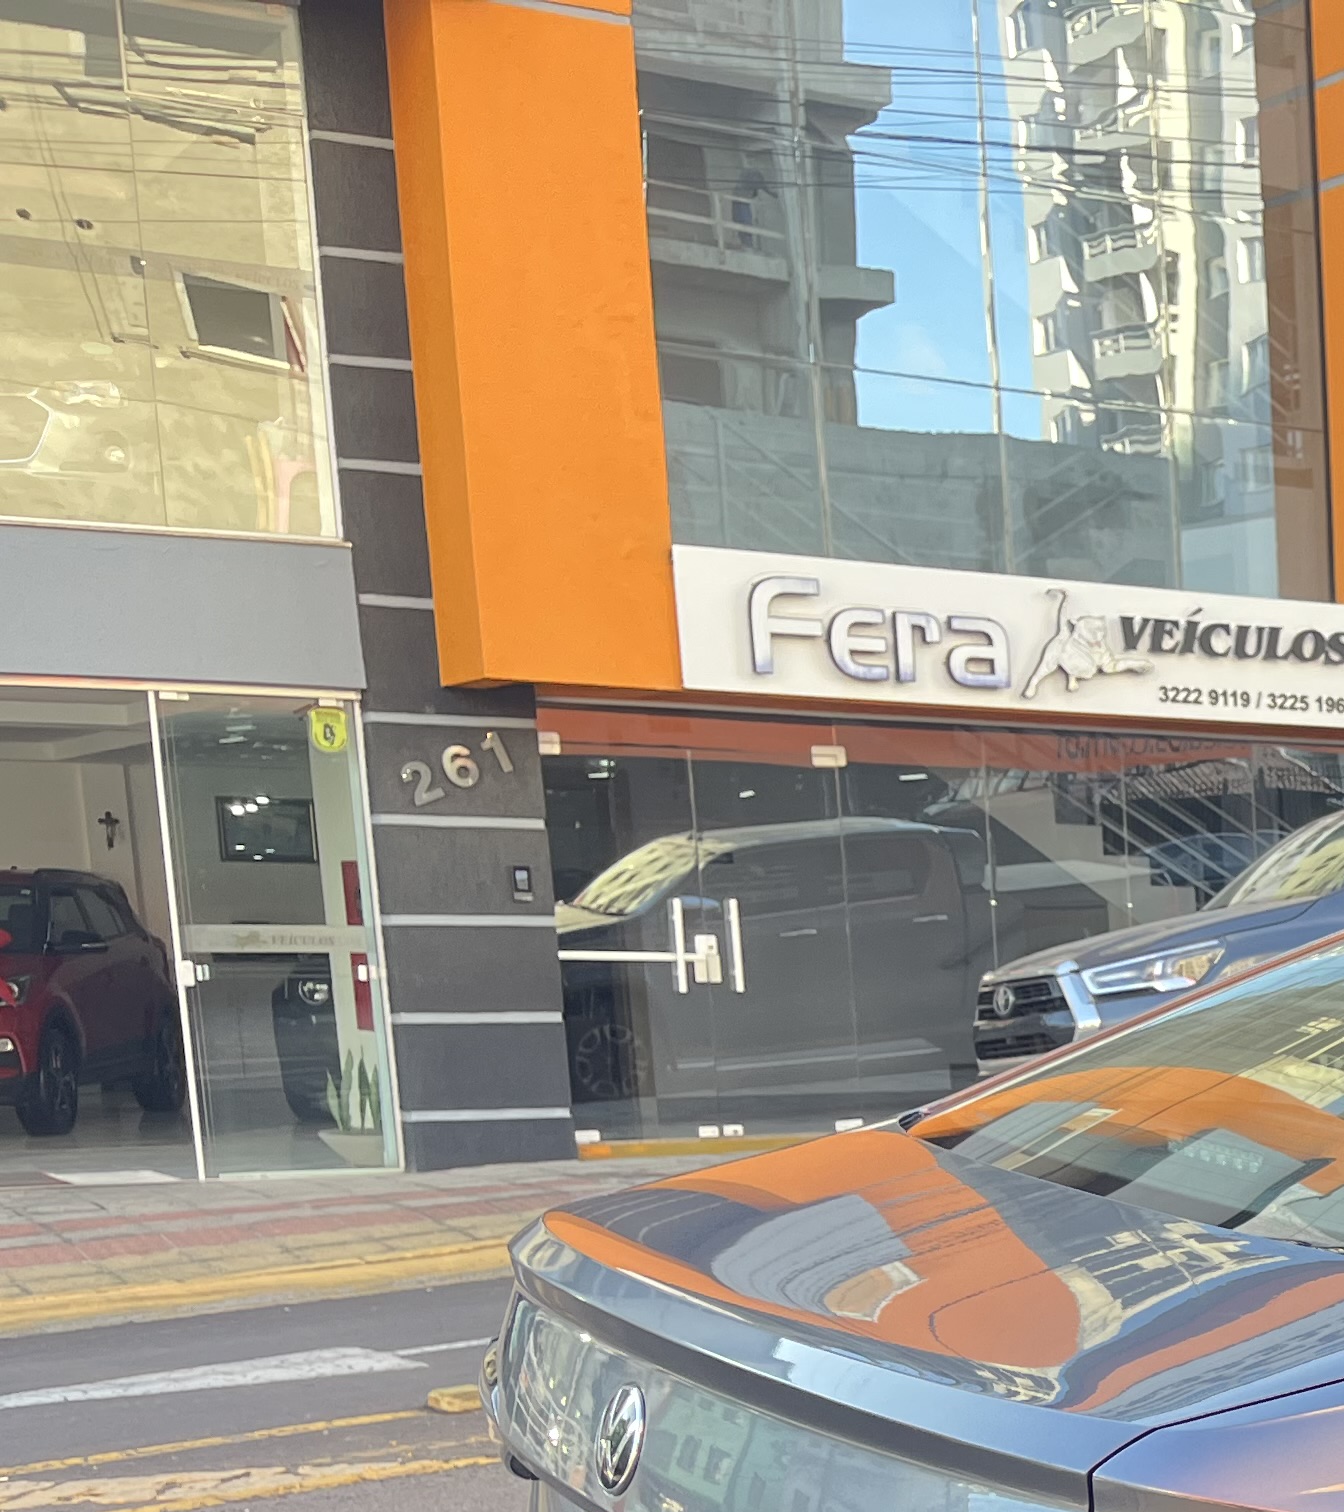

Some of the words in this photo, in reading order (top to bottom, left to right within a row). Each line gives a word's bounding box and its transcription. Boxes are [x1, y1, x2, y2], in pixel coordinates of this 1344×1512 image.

[749, 575, 1012, 690] Fera
[1158, 686, 1203, 706] 3222
[1207, 688, 1251, 709] 9119
[1267, 692, 1310, 713] 3225
[400, 730, 514, 807] 261
